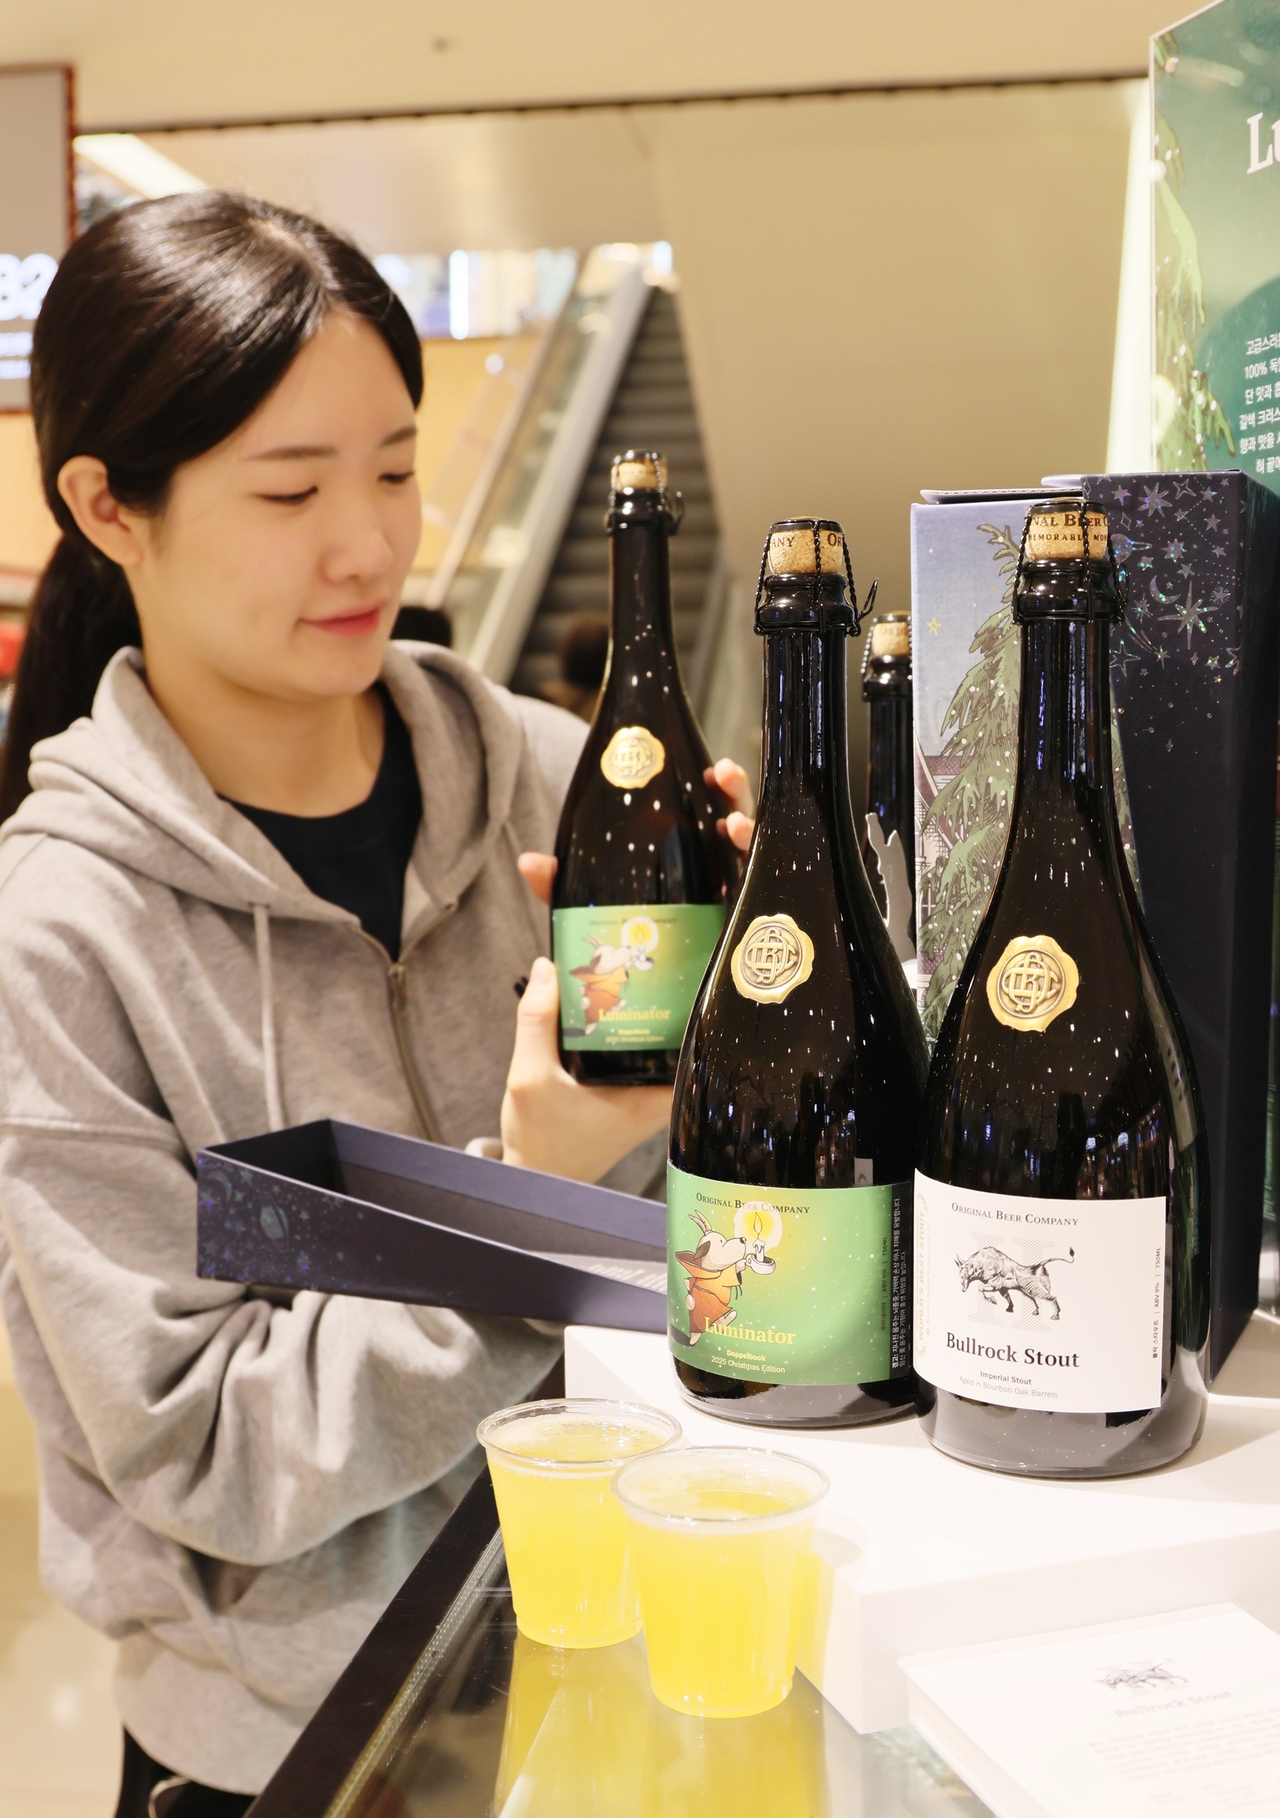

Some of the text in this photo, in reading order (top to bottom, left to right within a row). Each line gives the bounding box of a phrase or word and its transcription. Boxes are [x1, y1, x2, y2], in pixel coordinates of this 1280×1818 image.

[1244, 357, 1280, 379] 100% 독
[1245, 388, 1254, 405] 단
[1255, 384, 1272, 402] 맛과
[1239, 411, 1256, 430] 갈색
[1240, 438, 1257, 454] 향과
[1257, 432, 1275, 450] 맛을
[1255, 458, 1265, 474] 혀
[827, 532, 843, 548] OR
[598, 1008, 672, 1022] Luminator
[696, 1192, 733, 1208] ORIGINAL
[761, 1202, 811, 1214] COMPANY
[951, 1201, 1079, 1226] ORIGINAL BEER COMPANY
[1155, 1282, 1160, 1293] 9%
[704, 1316, 796, 1345] Luminator
[726, 1349, 767, 1362] Doppelbock
[946, 1331, 1080, 1368] Bullrock Stout
[711, 1355, 786, 1374] 2025 Christmas Edition
[959, 1375, 1059, 1398] Aged in Bourbon Oak Barrels
[980, 1370, 1032, 1385] Imperial Stout
